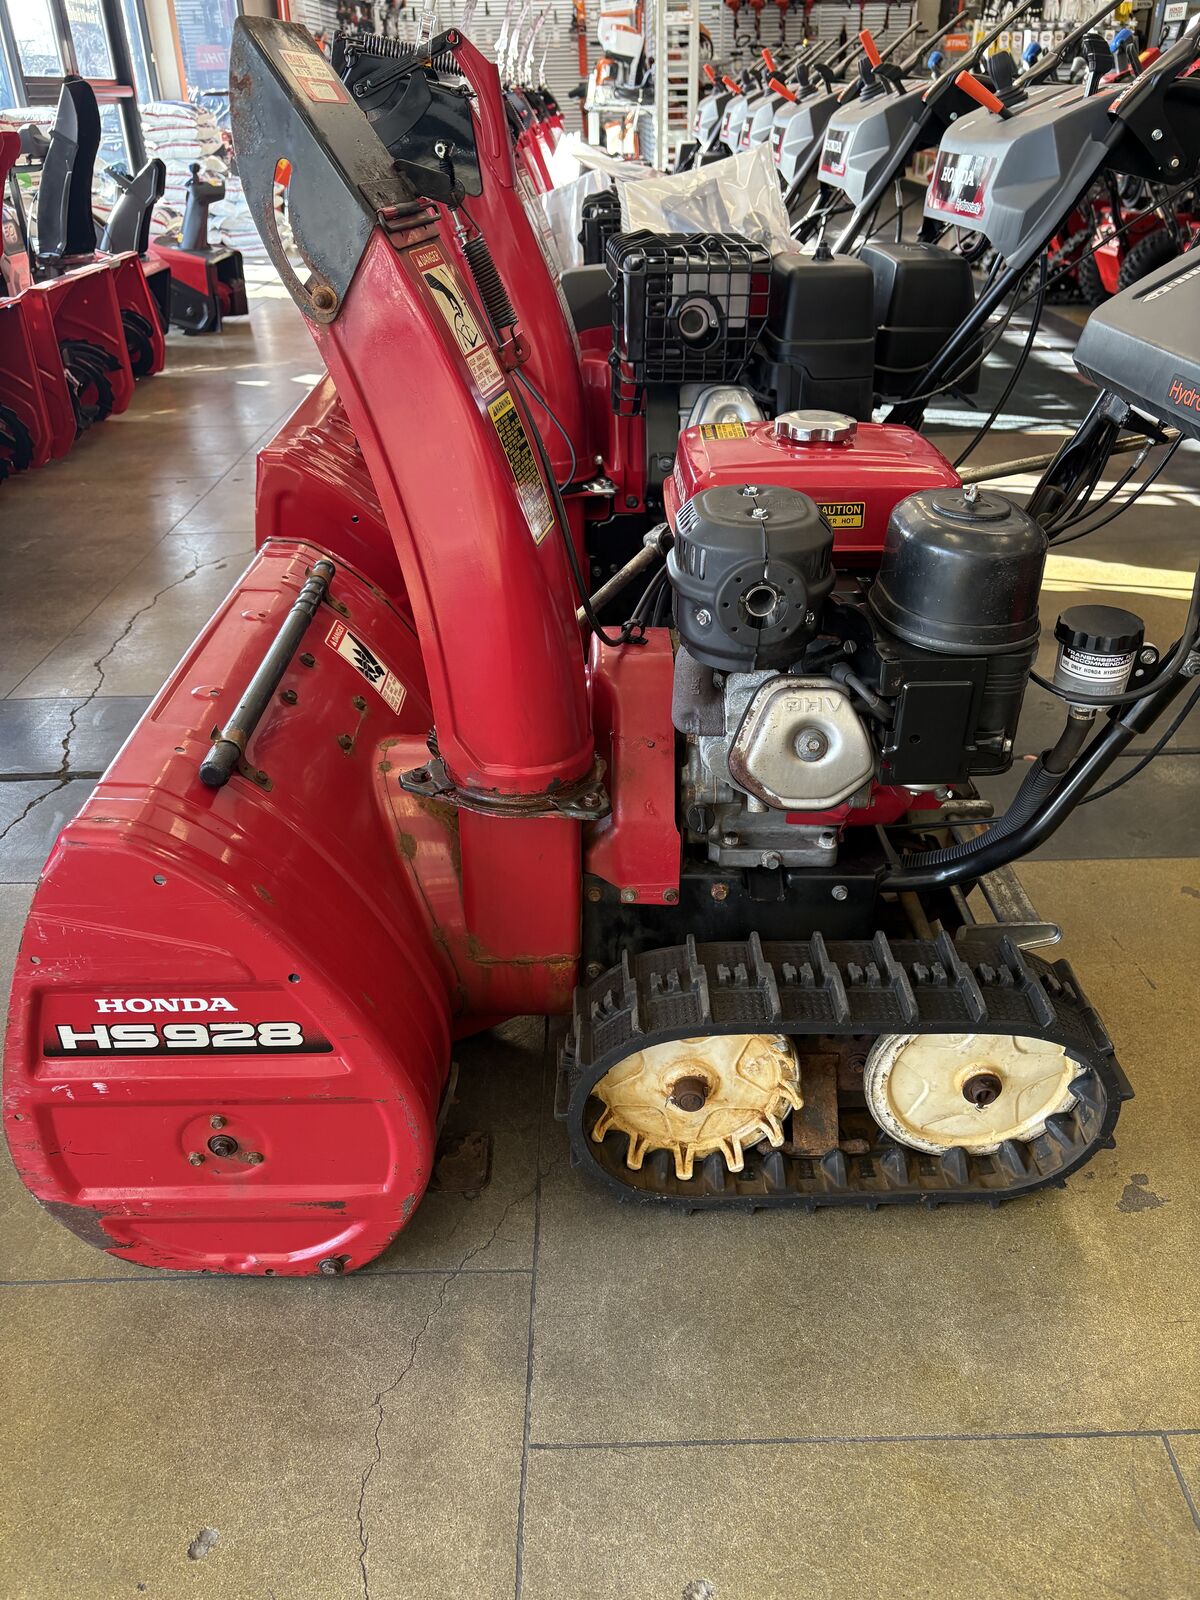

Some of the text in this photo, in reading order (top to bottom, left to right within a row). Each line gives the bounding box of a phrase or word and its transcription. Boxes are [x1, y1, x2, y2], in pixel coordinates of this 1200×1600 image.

[941, 166, 975, 187] HONDA
[841, 517, 856, 525] HOT
[1067, 647, 1124, 662] TRANSMISSION
[1070, 663, 1082, 672] ONLY
[1083, 666, 1102, 675] HONDA
[782, 696, 843, 713] OHV
[94, 997, 239, 1014] HONDA
[56, 1022, 305, 1050] HS928
